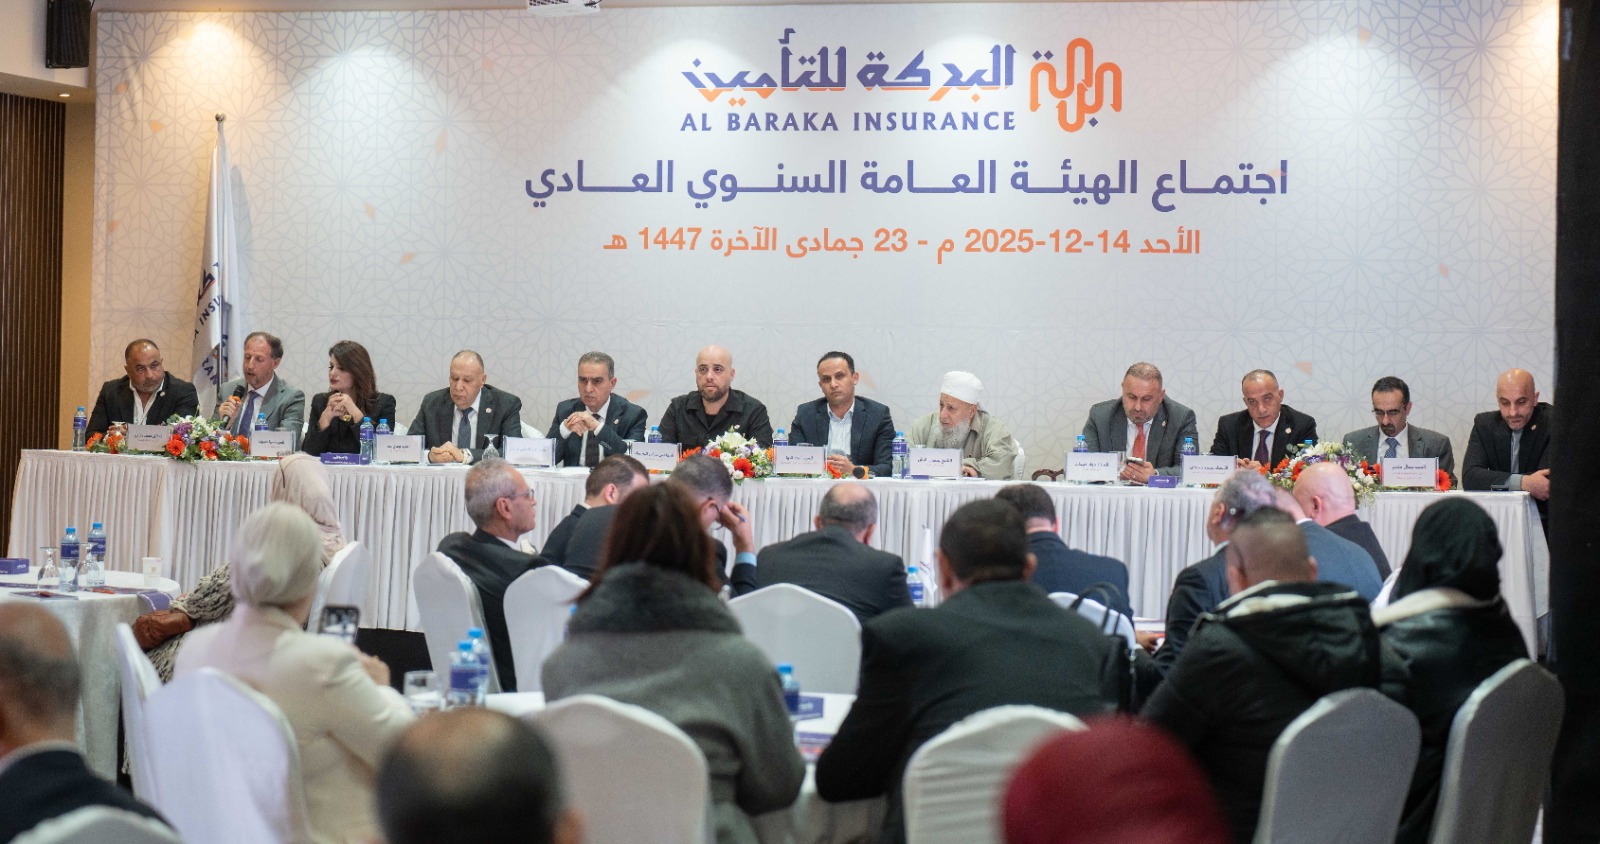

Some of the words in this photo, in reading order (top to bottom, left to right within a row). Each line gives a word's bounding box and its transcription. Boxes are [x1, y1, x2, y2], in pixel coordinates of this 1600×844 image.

[681, 28, 847, 106] للتأمين
[680, 113, 712, 132] AL
[727, 113, 839, 132] BARAKA
[853, 112, 1016, 132] INSURANCE
[524, 160, 674, 209] العادي
[687, 160, 848, 210] السنوي
[861, 160, 997, 195] العامة
[1010, 160, 1138, 207] الهيئة
[1152, 160, 1289, 213] اجتماع
[640, 228, 703, 252] 1447
[710, 225, 778, 258] الآخرة
[785, 228, 865, 260] جمادى
[874, 228, 909, 254] 23
[938, 239, 956, 266] م
[1140, 226, 1202, 255] الأحد
